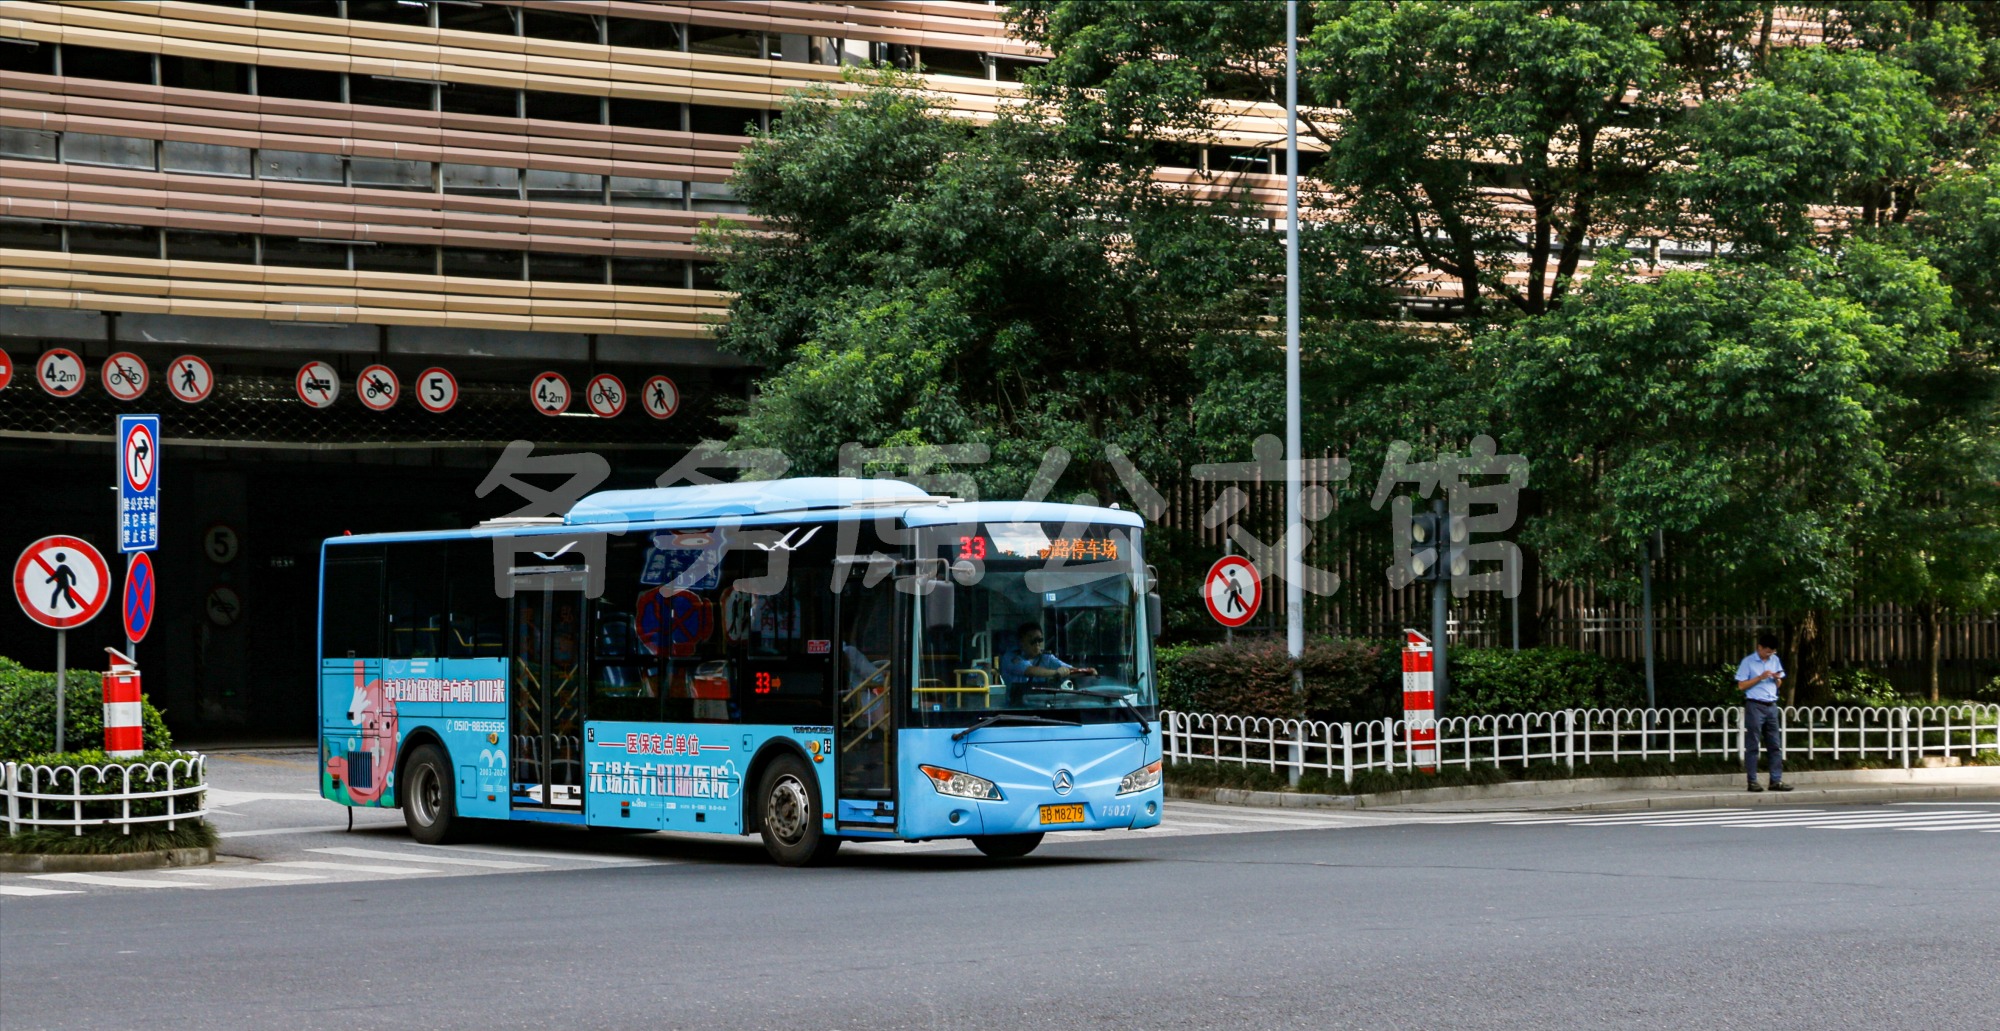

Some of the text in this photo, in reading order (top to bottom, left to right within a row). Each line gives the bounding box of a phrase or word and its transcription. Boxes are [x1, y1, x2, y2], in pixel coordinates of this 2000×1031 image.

[46, 362, 77, 382] 4.2m
[429, 378, 445, 402] 5
[537, 384, 564, 403] 4.2m
[123, 512, 156, 527] 其它车辆
[214, 532, 230, 557] 5
[959, 536, 986, 560] 33
[384, 678, 505, 703] 市妇幼保健院向南100米
[754, 672, 771, 694] 33
[453, 720, 505, 732] 0510-88353535
[626, 733, 700, 755] 医保定点单位
[589, 761, 730, 798] 无锡东方肛肠医院
[1102, 804, 1131, 816] 75027
